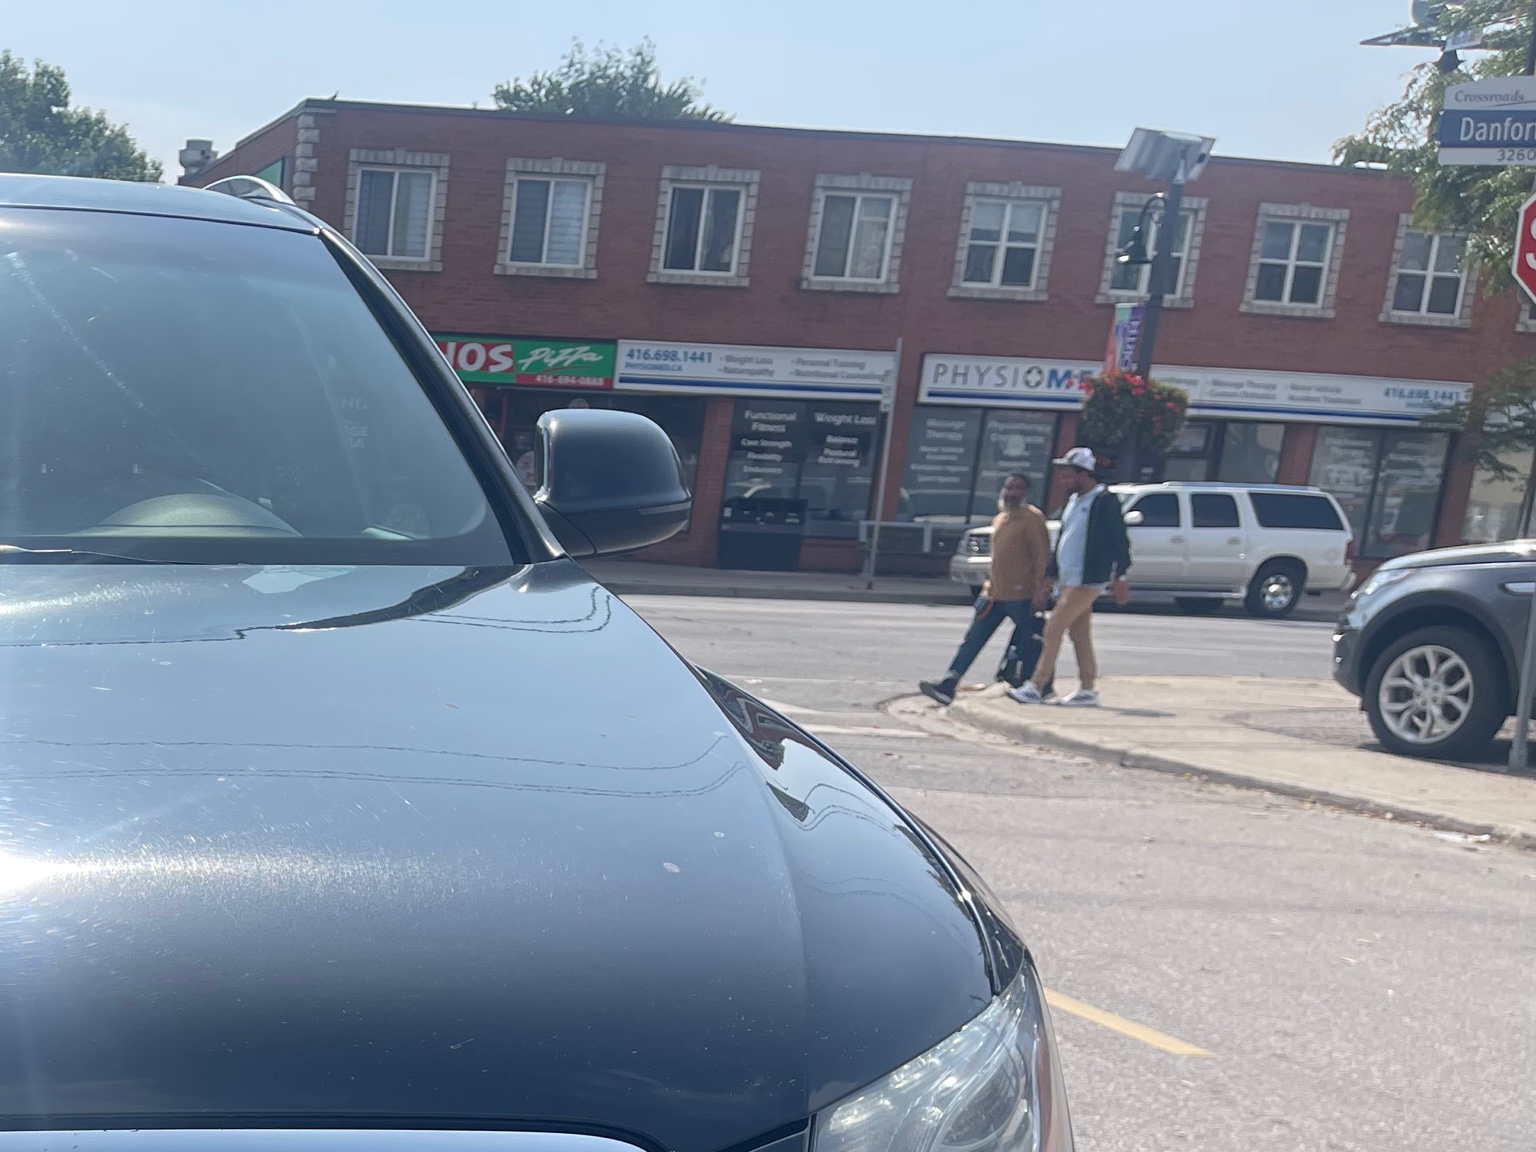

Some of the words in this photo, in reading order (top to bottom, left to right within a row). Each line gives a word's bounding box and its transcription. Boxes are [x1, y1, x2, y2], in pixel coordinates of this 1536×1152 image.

[1454, 89, 1525, 103] Crossroads
[1459, 116, 1536, 141] Danfor
[625, 348, 713, 363] 416.698.1441
